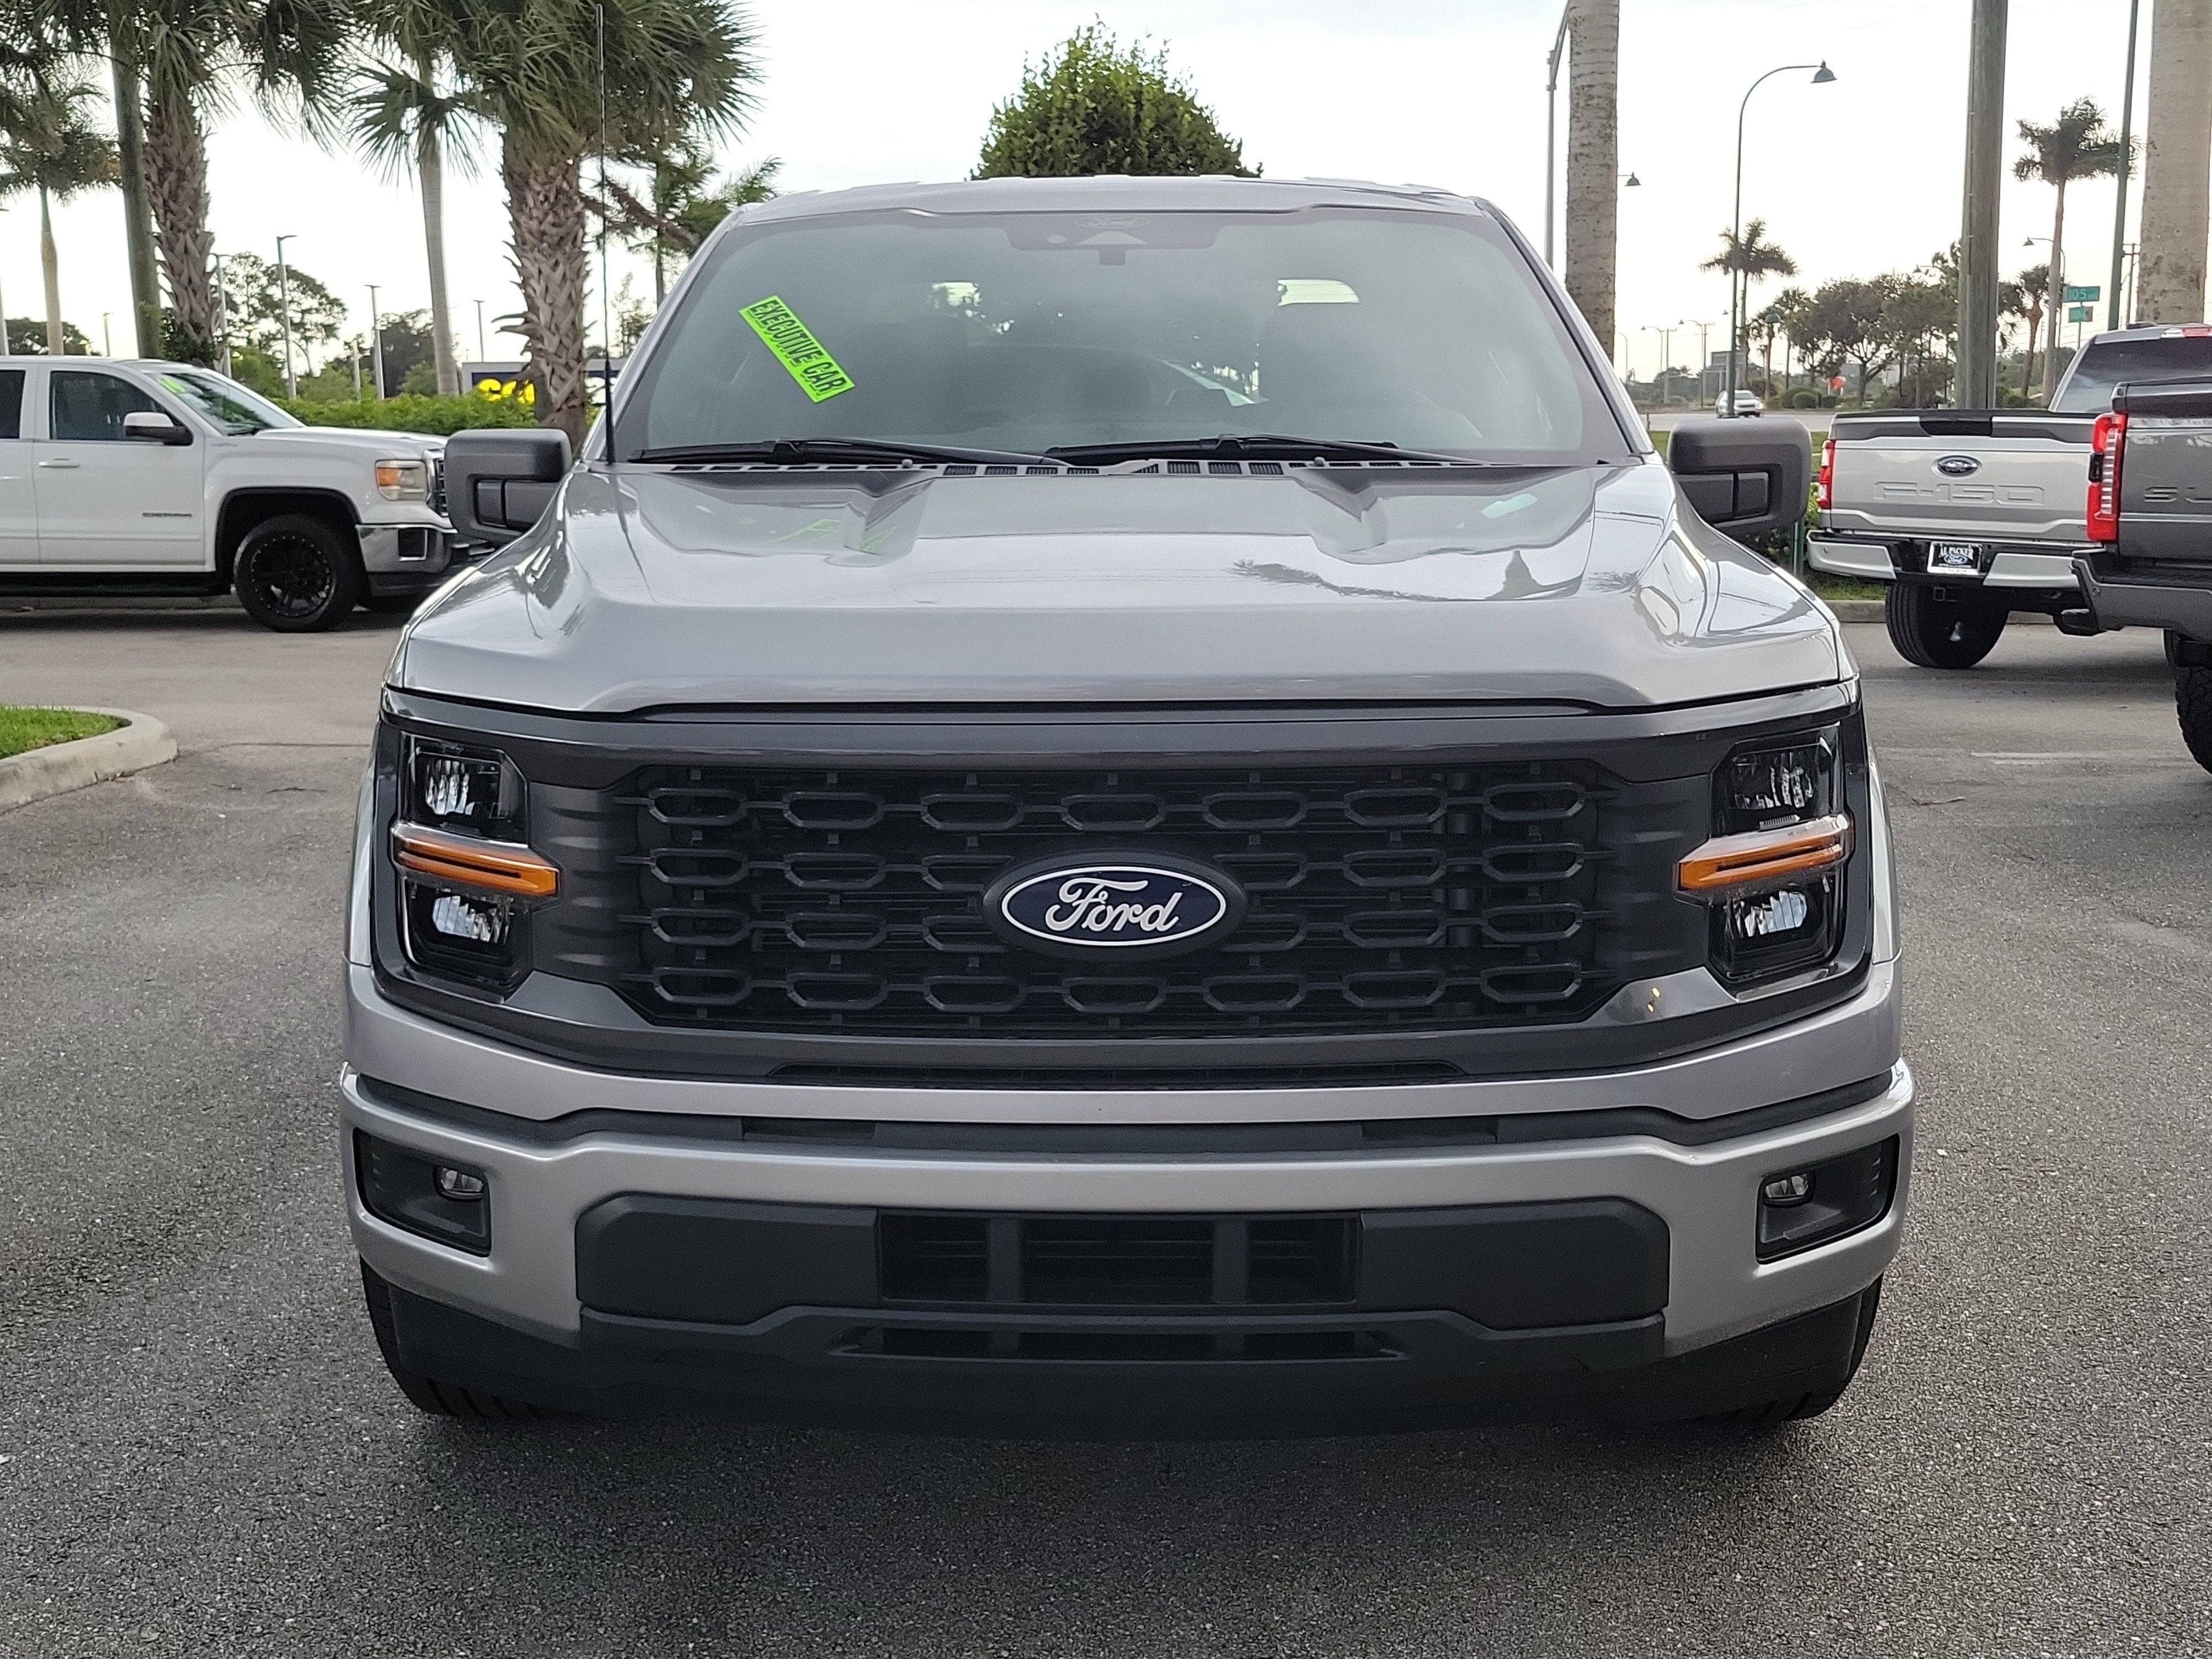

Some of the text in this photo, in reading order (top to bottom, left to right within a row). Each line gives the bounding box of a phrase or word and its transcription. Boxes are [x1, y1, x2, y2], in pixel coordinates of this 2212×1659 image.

[2069, 289, 2086, 300] 105
[747, 300, 847, 395] EXECUTIVE CAR
[1872, 481, 2044, 505] F-150
[1938, 543, 1974, 560] AL PACKER
[1046, 877, 1183, 932] Ford
